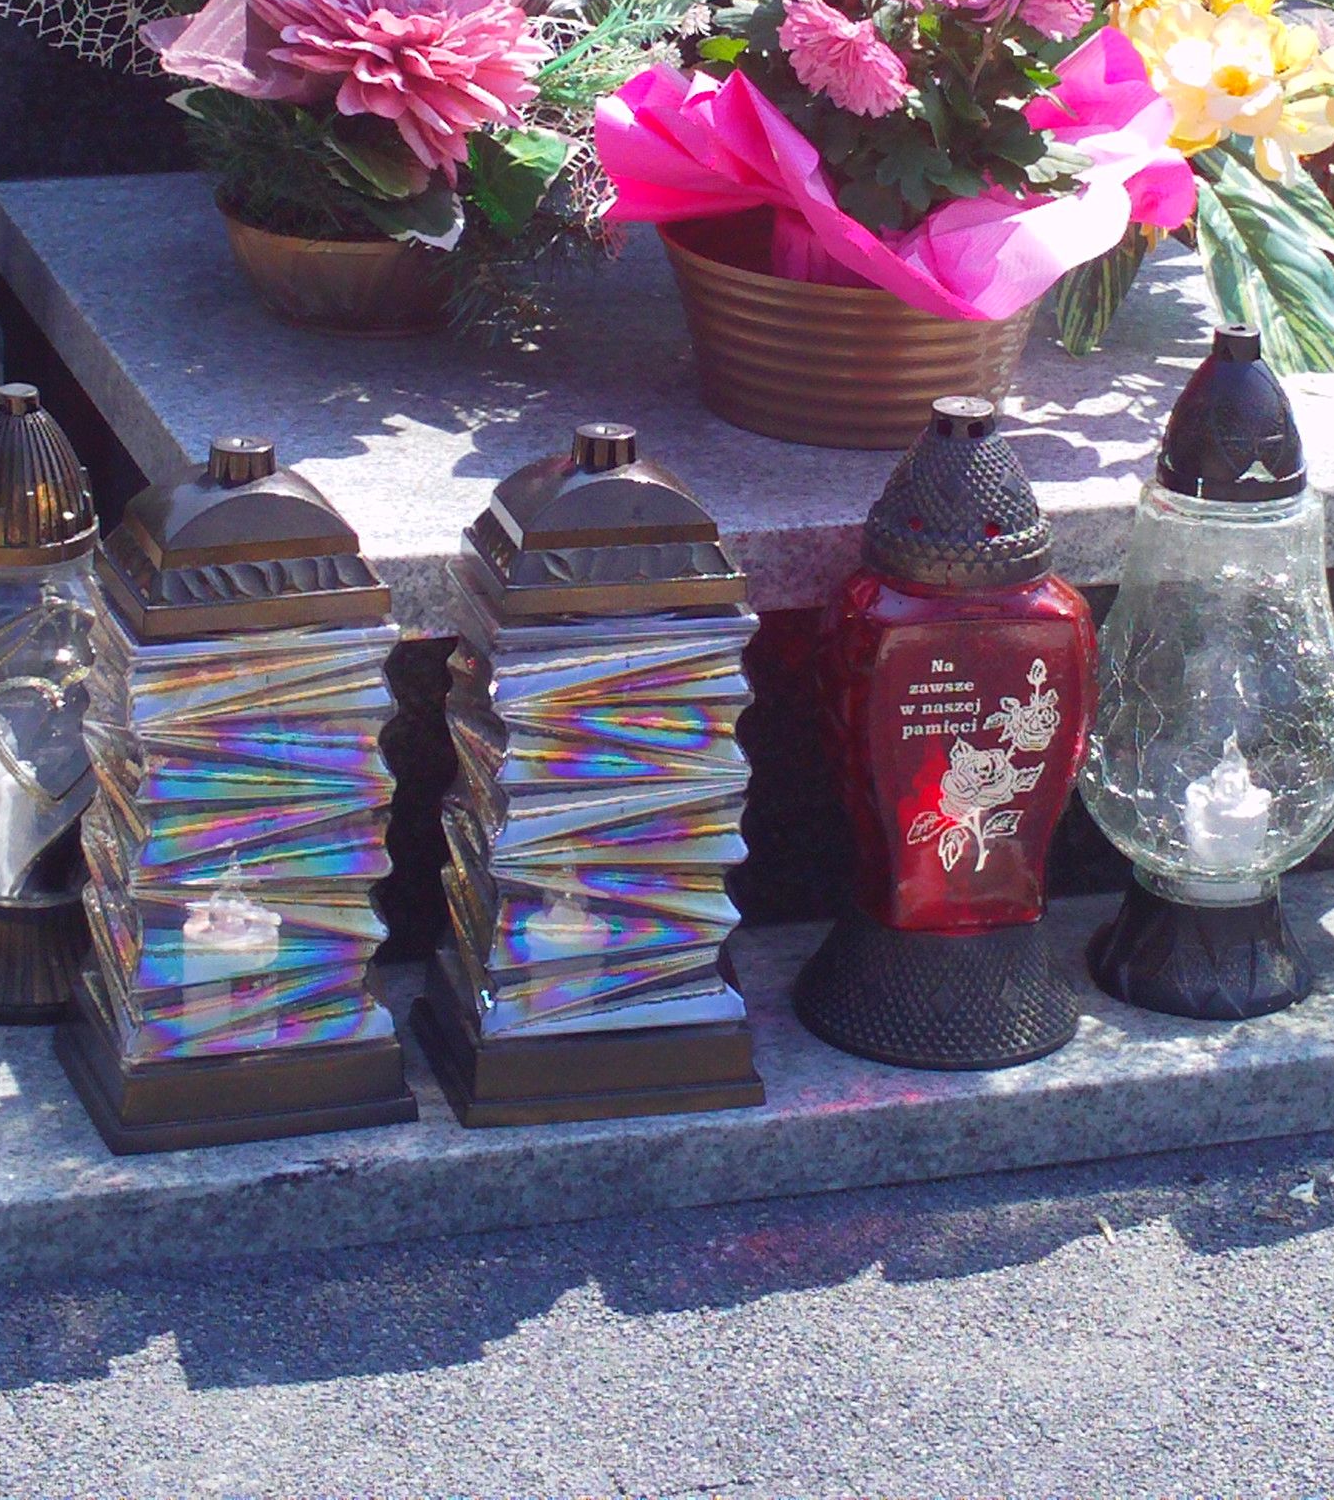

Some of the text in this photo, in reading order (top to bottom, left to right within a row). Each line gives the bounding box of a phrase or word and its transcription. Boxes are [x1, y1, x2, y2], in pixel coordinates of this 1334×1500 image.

[931, 659, 954, 673] Na
[908, 680, 975, 695] zawsze
[900, 698, 981, 716] w naszej
[902, 718, 977, 740] pamięci
